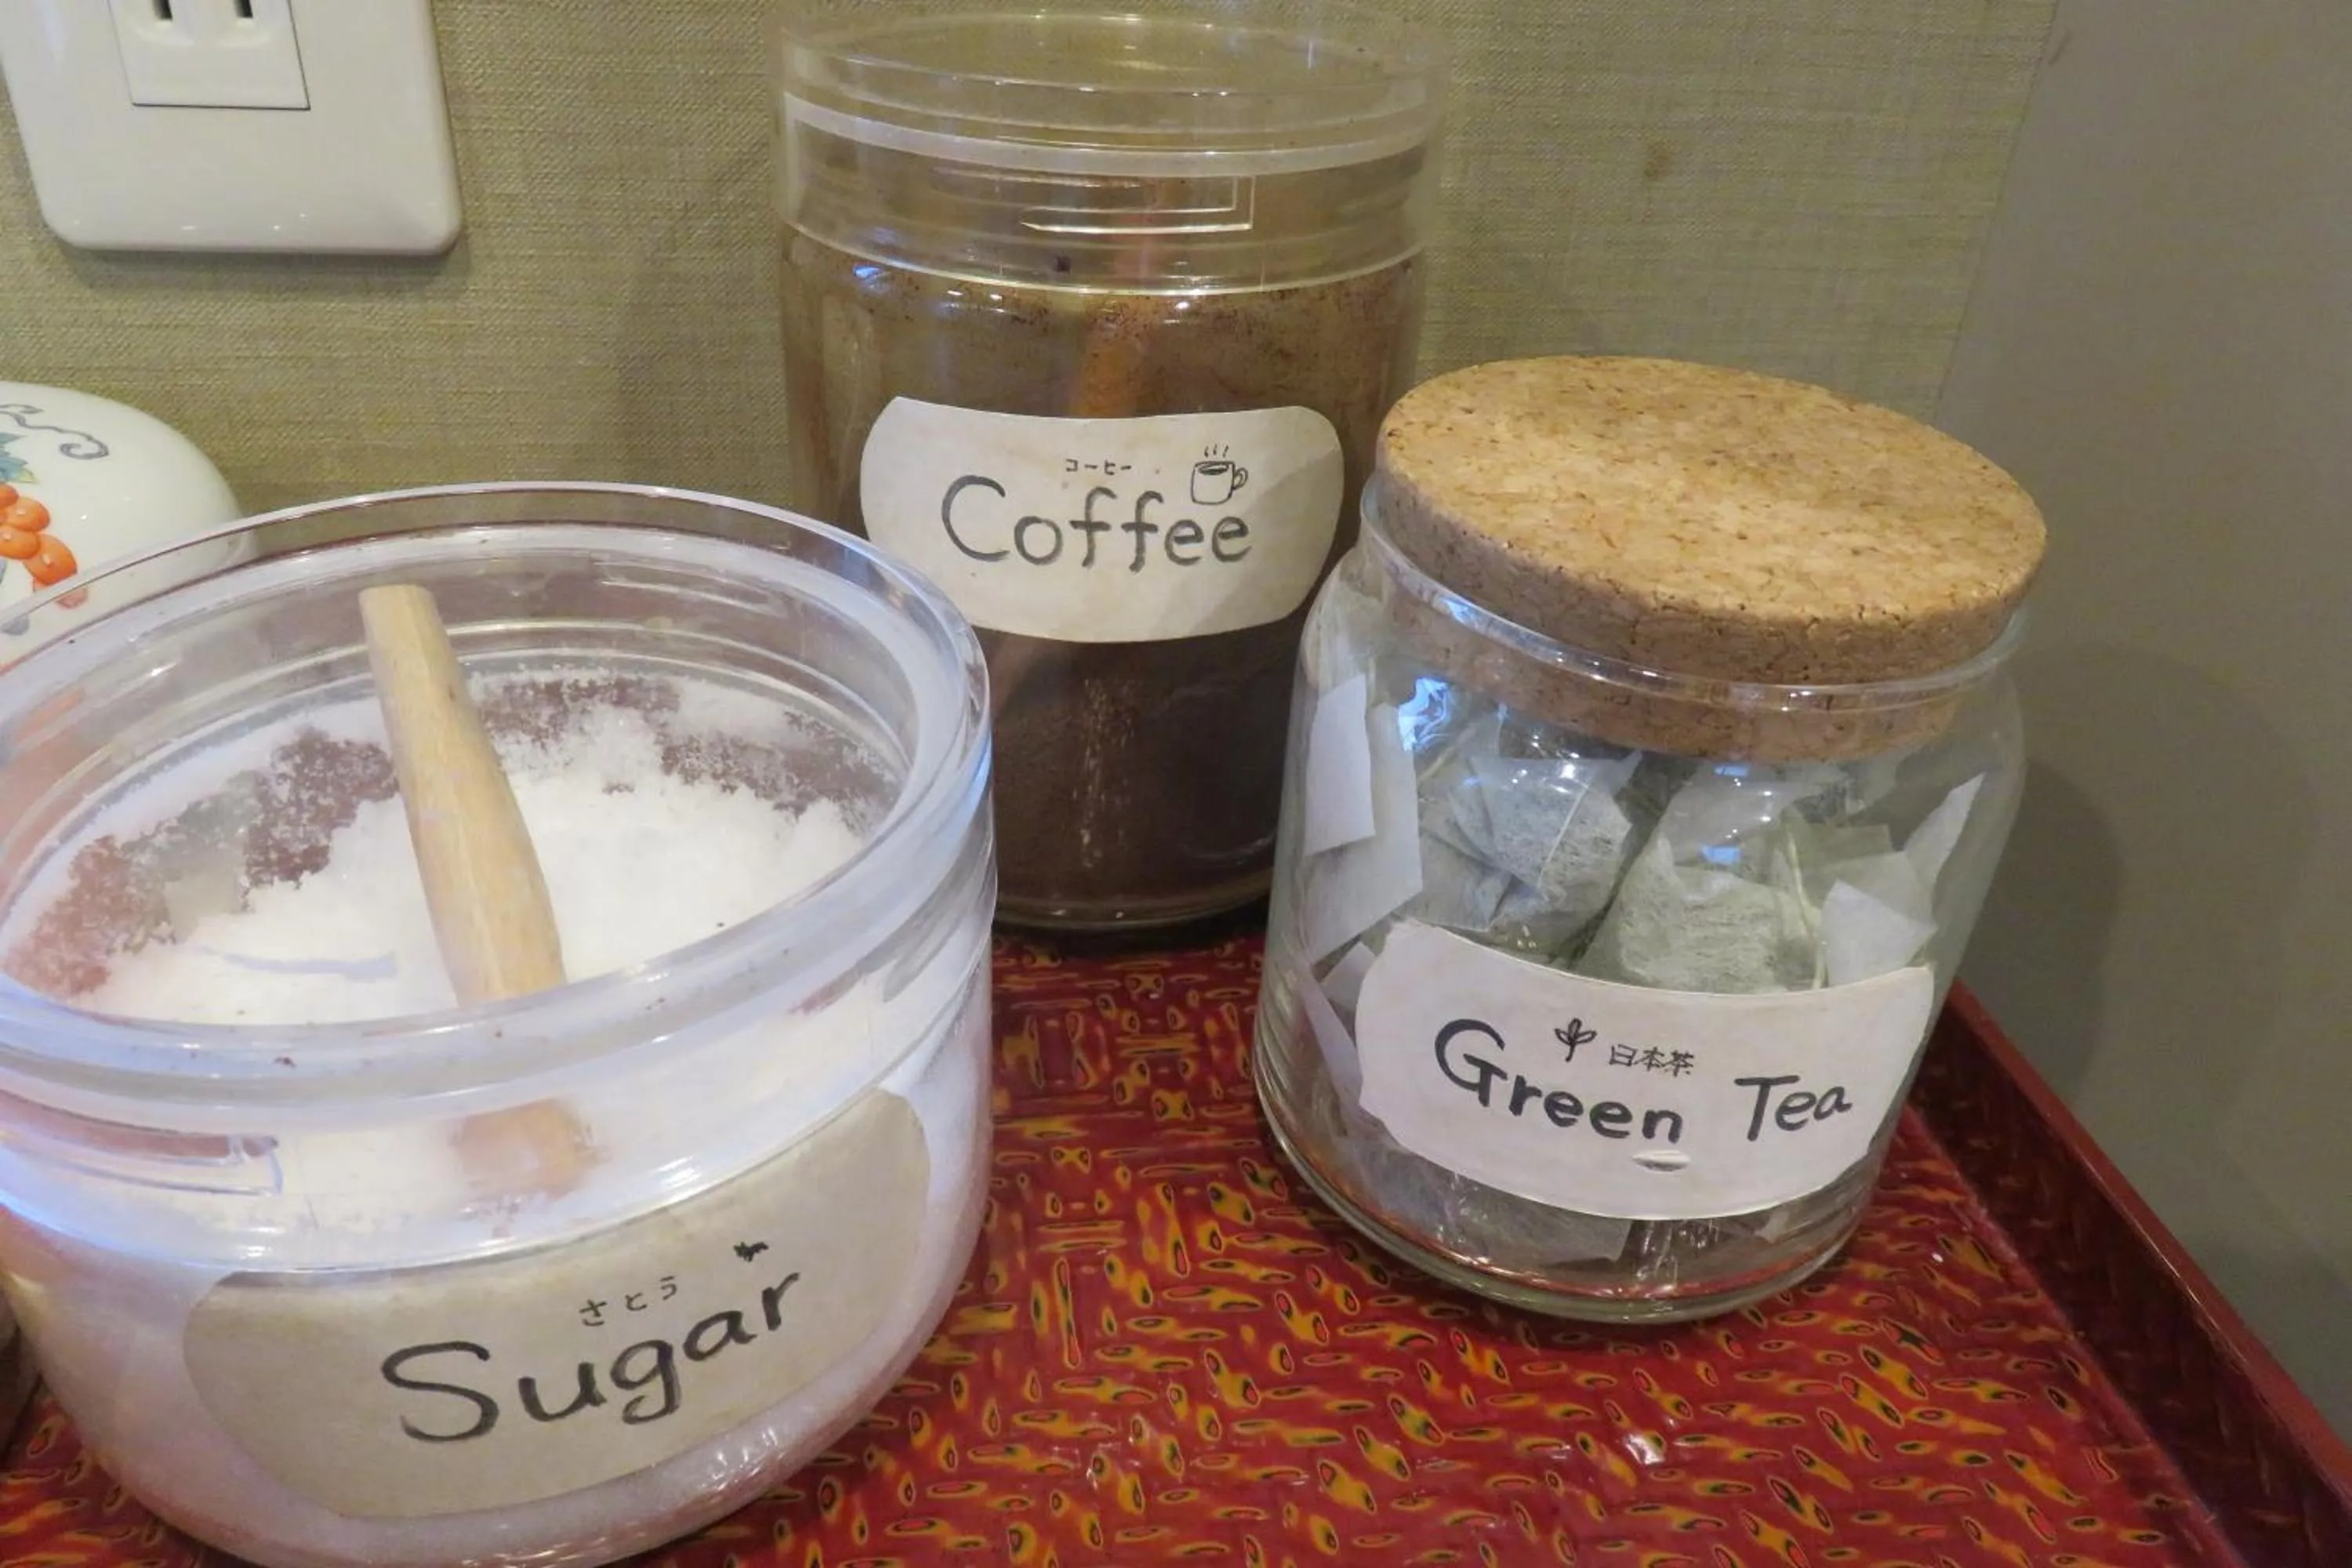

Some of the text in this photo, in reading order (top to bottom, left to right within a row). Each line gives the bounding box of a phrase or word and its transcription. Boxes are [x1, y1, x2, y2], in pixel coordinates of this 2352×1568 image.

[1065, 458, 1133, 476] コーヒー
[941, 474, 1253, 573] Coffee
[1434, 1018, 1853, 1144] Green Tea
[1607, 1042, 1696, 1077] 日本茶
[579, 1274, 679, 1328] さとう
[380, 1271, 802, 1443] Sugar
